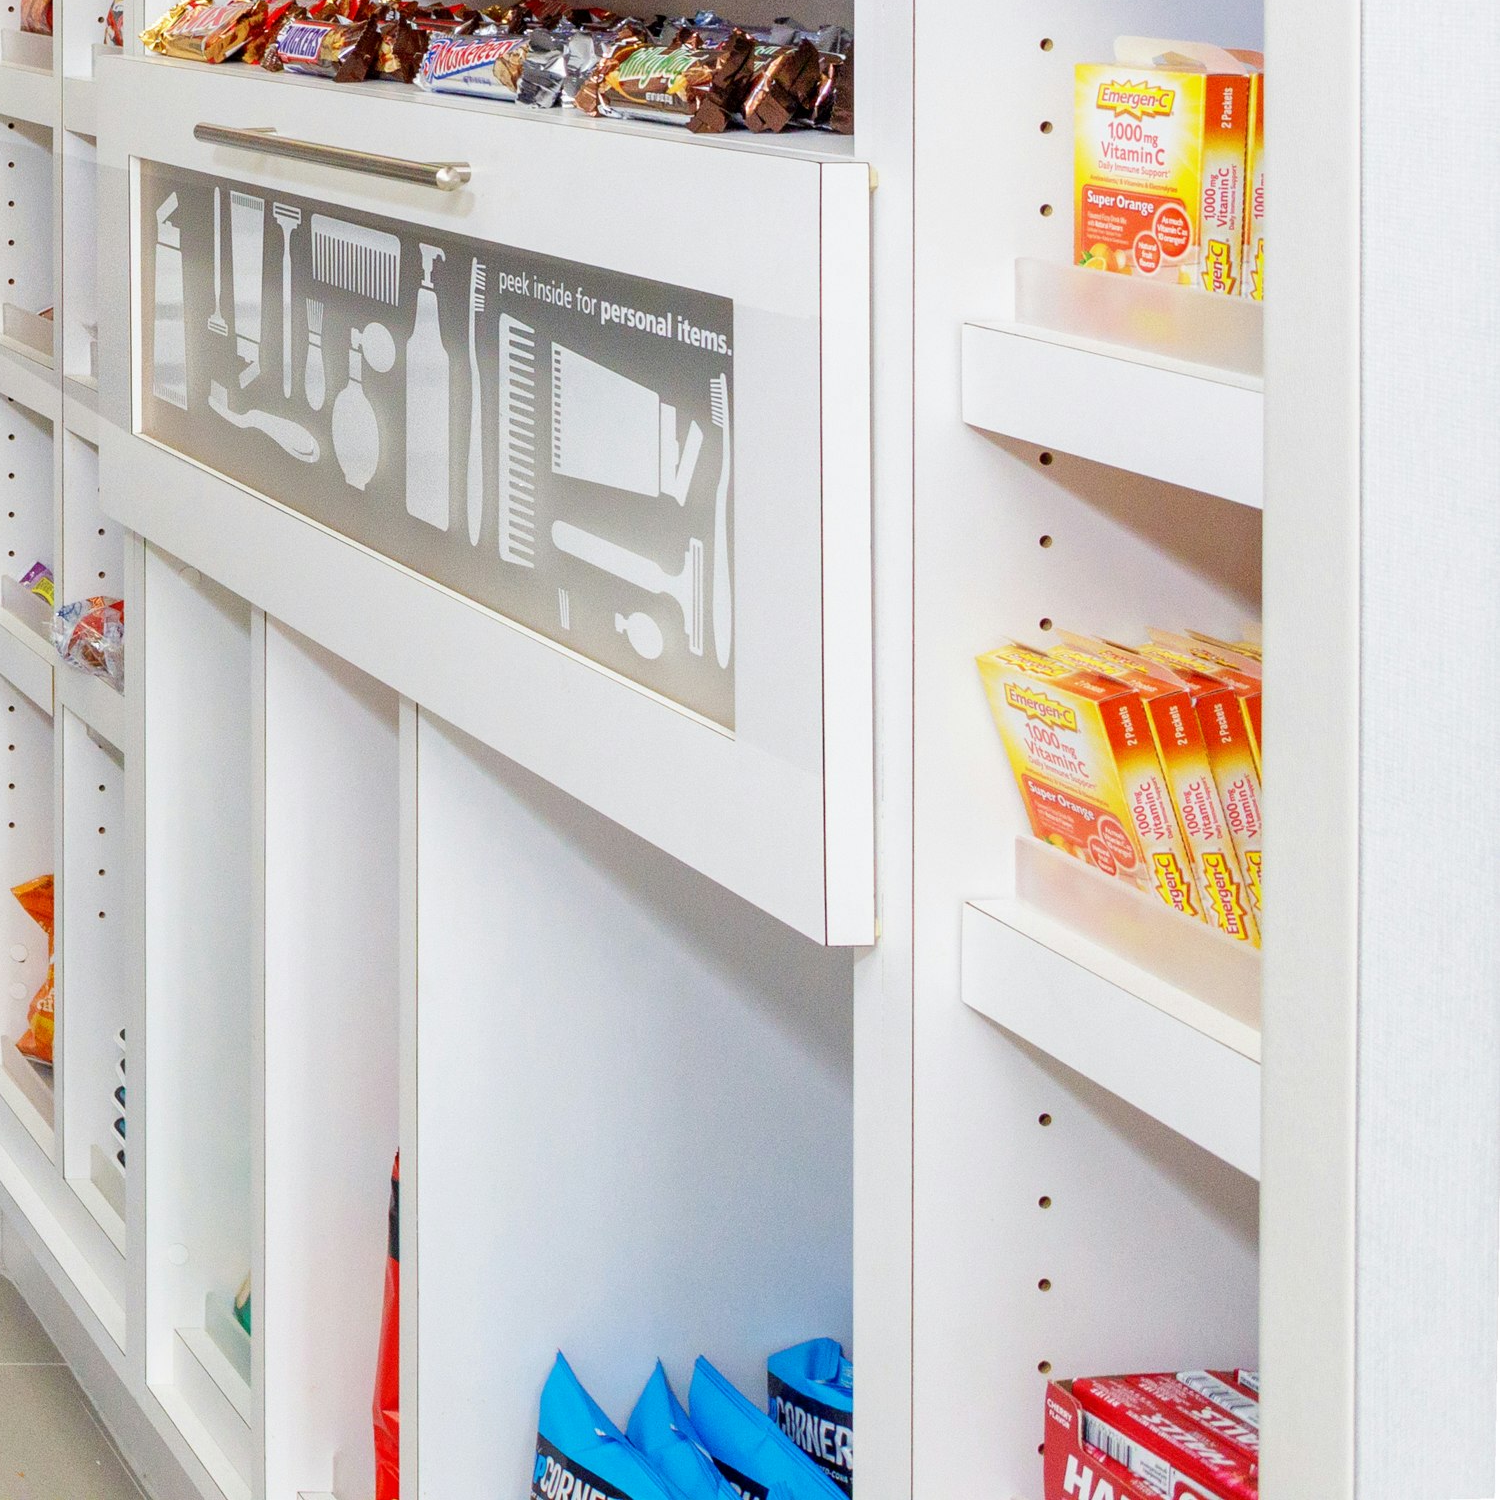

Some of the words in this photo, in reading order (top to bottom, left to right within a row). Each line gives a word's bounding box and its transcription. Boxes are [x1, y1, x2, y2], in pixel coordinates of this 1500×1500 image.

[1101, 86, 1170, 110] Emergen-C
[1221, 87, 1234, 121] Packets
[1107, 121, 1142, 143] 1,000
[1143, 132, 1158, 148] mg
[1221, 121, 1232, 129] 2
[1098, 160, 1113, 172] Daily
[1114, 162, 1140, 174] Immune
[1101, 141, 1153, 164] Vitamin
[1155, 148, 1165, 166] C
[1219, 167, 1230, 177] C
[1087, 190, 1115, 208] Super
[1116, 195, 1154, 216] Orange
[1204, 187, 1216, 221] 1,000
[1210, 174, 1218, 187] mg
[1216, 178, 1228, 229] Vitamin
[499, 271, 529, 297] peek
[533, 275, 572, 309] inside
[576, 286, 598, 315] for
[600, 300, 672, 339] personal
[677, 315, 733, 357] items.
[1009, 688, 1073, 724] Emergen-C
[1116, 706, 1135, 737] Packets
[1169, 705, 1186, 736] Packets
[1214, 702, 1231, 735] Packets
[1025, 722, 1060, 749] 1,000
[1061, 743, 1078, 760] mg
[1127, 736, 1138, 747] 2
[1177, 736, 1188, 746] 2
[1024, 737, 1077, 774] Vitamin
[1078, 761, 1090, 778] C
[1028, 780, 1057, 802] Super
[1057, 794, 1096, 821] Orange
[1140, 794, 1163, 841] Vitamin
[1191, 794, 1213, 841] Vitamin
[1205, 857, 1239, 934] Emergen-C
[1047, 1398, 1073, 1421] CHERRY
[1048, 1410, 1071, 1429] FLAVOR
